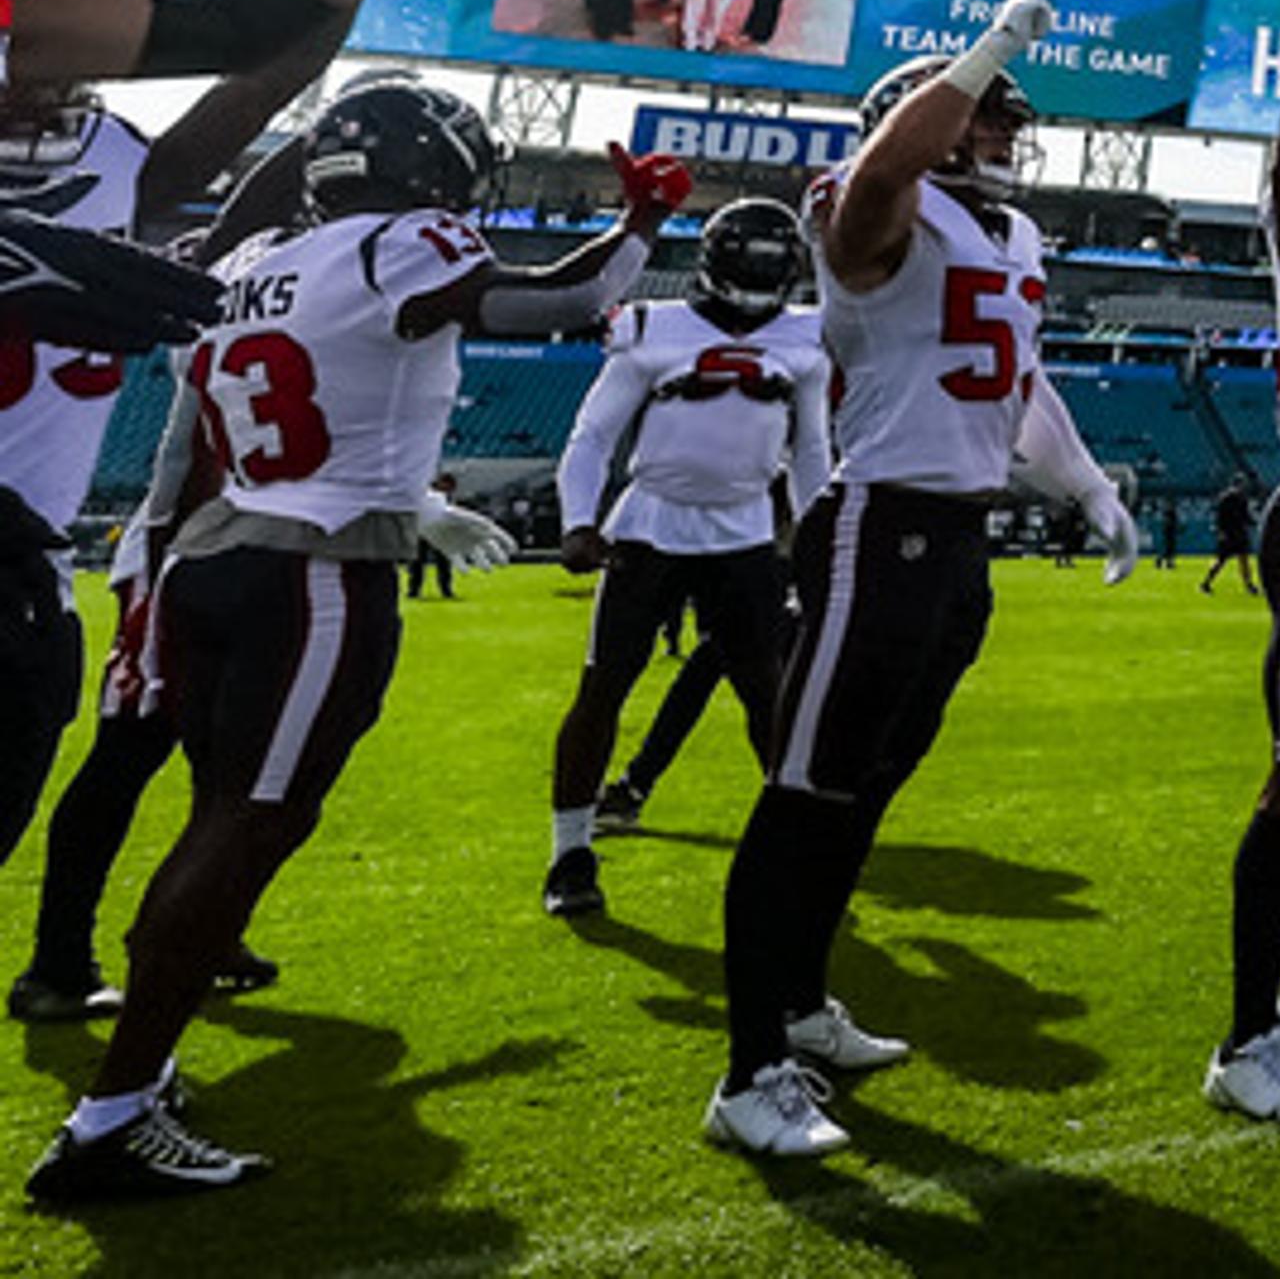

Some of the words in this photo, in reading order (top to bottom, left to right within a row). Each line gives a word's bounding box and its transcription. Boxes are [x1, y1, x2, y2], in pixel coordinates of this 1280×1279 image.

[883, 25, 966, 53] TEAM
[1027, 41, 1081, 67] THE
[1090, 48, 1171, 80] GAME
[654, 118, 798, 165] BUD
[417, 219, 486, 265] 13
[936, 265, 1047, 404] 5
[188, 332, 331, 486] 13
